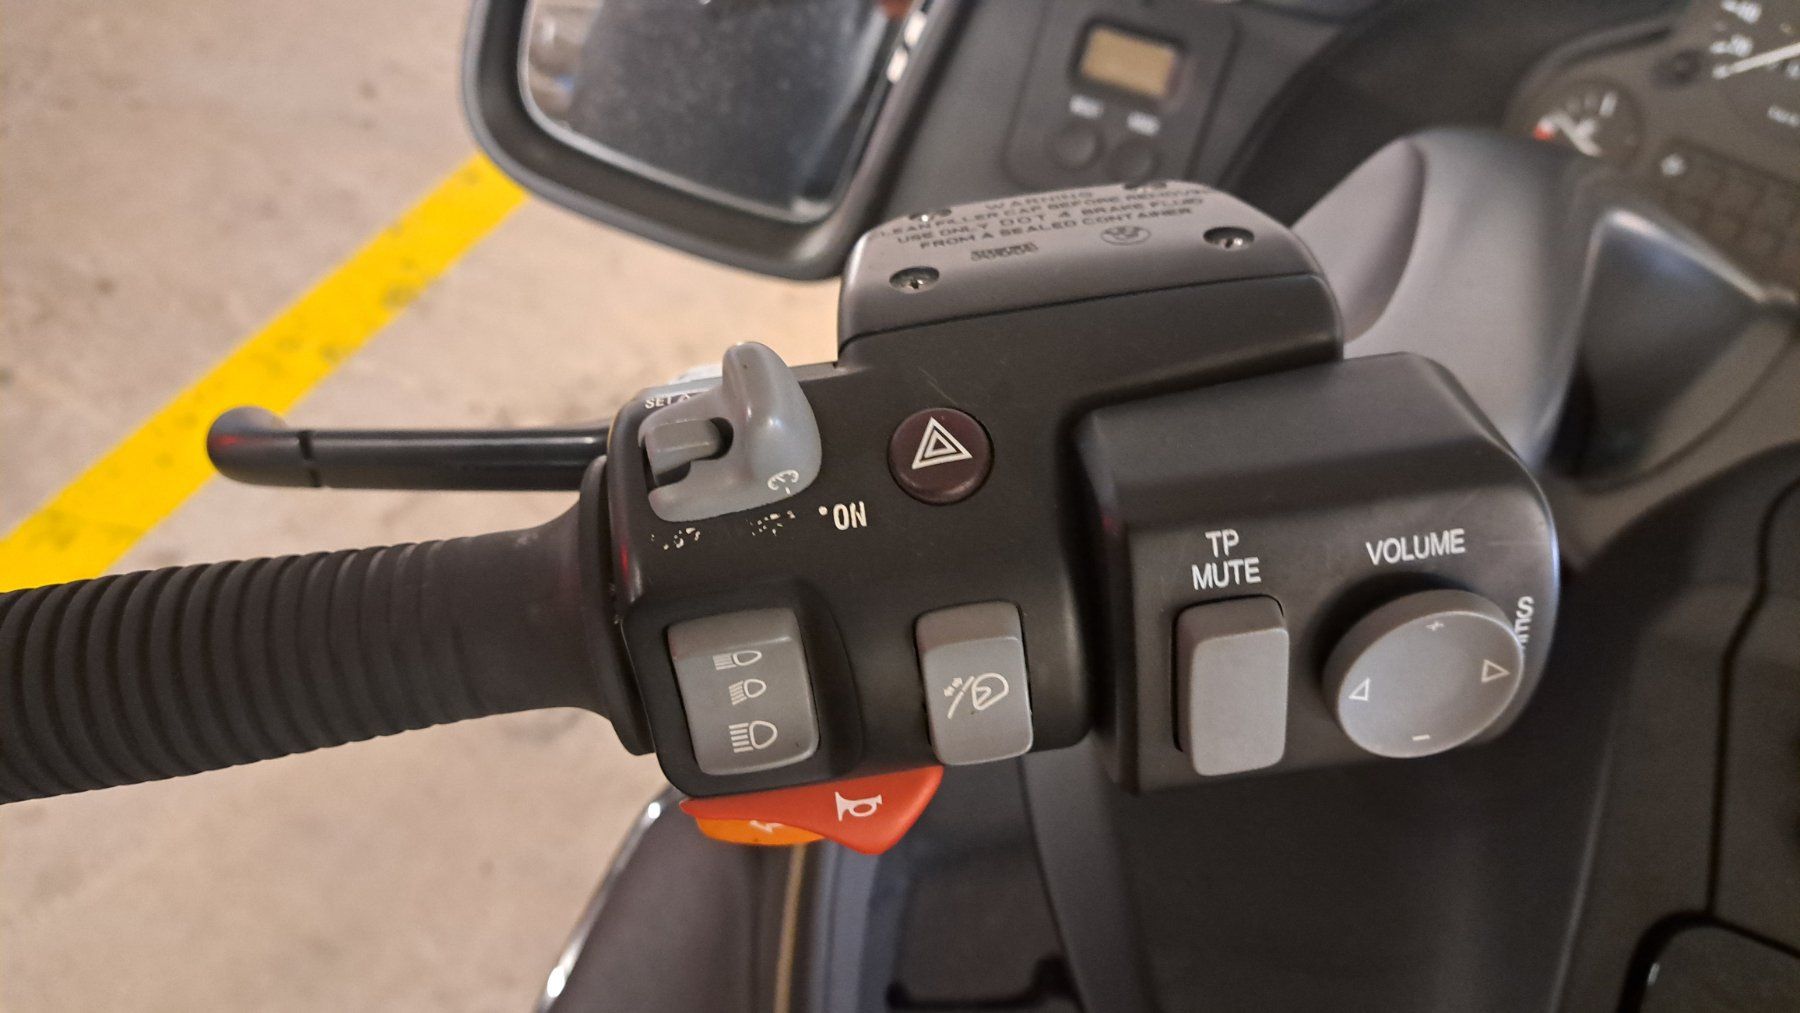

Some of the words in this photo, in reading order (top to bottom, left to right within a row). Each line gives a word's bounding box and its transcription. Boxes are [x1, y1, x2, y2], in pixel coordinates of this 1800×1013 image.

[897, 232, 932, 244] USE
[940, 223, 988, 237] ONLY
[1081, 203, 1143, 215] BRAKE
[920, 234, 975, 249] FROM
[982, 231, 994, 239] A
[1000, 219, 1077, 236] SEALED
[1081, 207, 1192, 226] CONTAINER
[645, 394, 673, 409] SET
[1205, 529, 1239, 557] TP
[1365, 528, 1466, 565] VOLUME
[1192, 557, 1262, 590] MUTE
